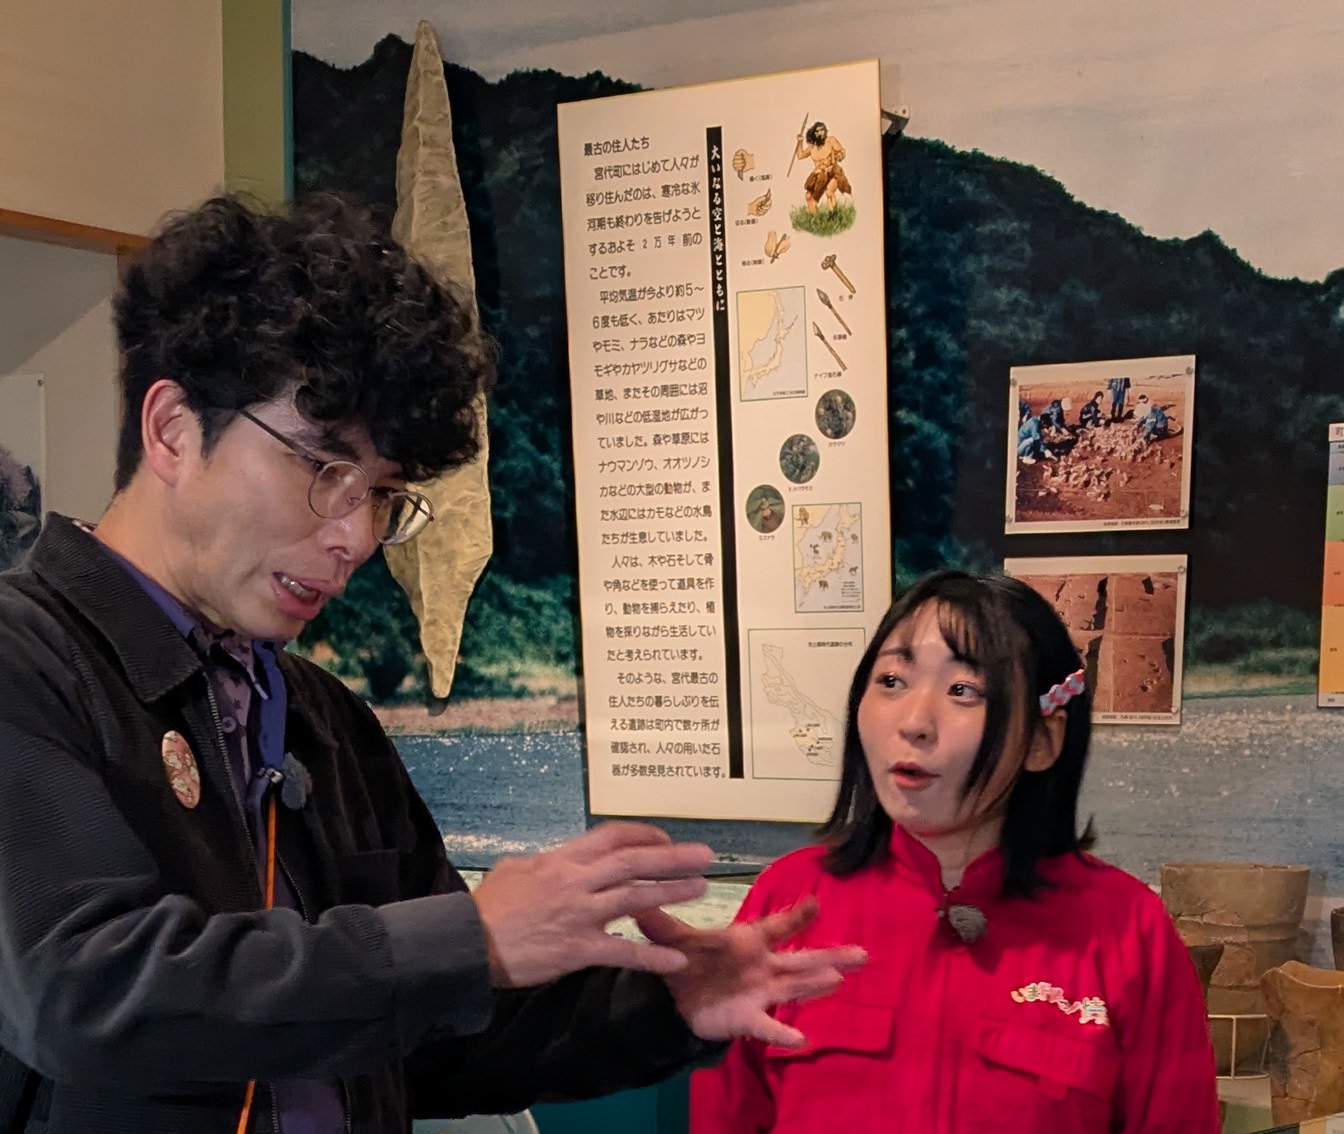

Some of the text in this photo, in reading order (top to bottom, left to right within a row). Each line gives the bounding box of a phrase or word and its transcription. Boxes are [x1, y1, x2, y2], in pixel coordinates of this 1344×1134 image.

[584, 136, 650, 156] 最古の住人たち
[595, 155, 699, 180] 宮代町にはじめて人々が
[586, 182, 701, 206] 移り住んだのは、寒冷な氷
[587, 207, 701, 231] 河期も終わりを告げようと
[711, 144, 726, 312] 大いなる空と海とともに
[590, 266, 631, 279] ことです。
[593, 308, 705, 329] 6度も低く、あたりはマツ
[593, 333, 706, 353] やモミ、ナラなどの森やヨ
[594, 358, 707, 377] モギやカヤツリグサなどの
[595, 383, 707, 401] 草地、またその周囲には沼
[596, 408, 708, 425] や川などの低湿地が広がっ
[598, 433, 709, 448] ていました。森や草原には
[599, 455, 711, 474] ナウマンゾウ、オオツノシ
[600, 481, 711, 498] カなどの大型の動物が、ま
[601, 505, 712, 521] た水辺にはカモなどの水鳥
[602, 530, 708, 545] たちが生息していました。
[612, 553, 714, 568] 人々は、木や石そして骨
[604, 578, 714, 592] や角などを使って道具を作
[605, 601, 715, 616] り、動物を捕らえたり、植
[606, 624, 716, 639] 物を採りながら生活してい
[607, 648, 703, 662] たと考えられています。
[617, 672, 718, 686] そのような、宮代最古の
[609, 695, 719, 709] 住人たちの暮らしぶりを伝
[611, 741, 721, 755] 確認され、人々の用いた石
[612, 764, 726, 779] 器が多数発見されています。
